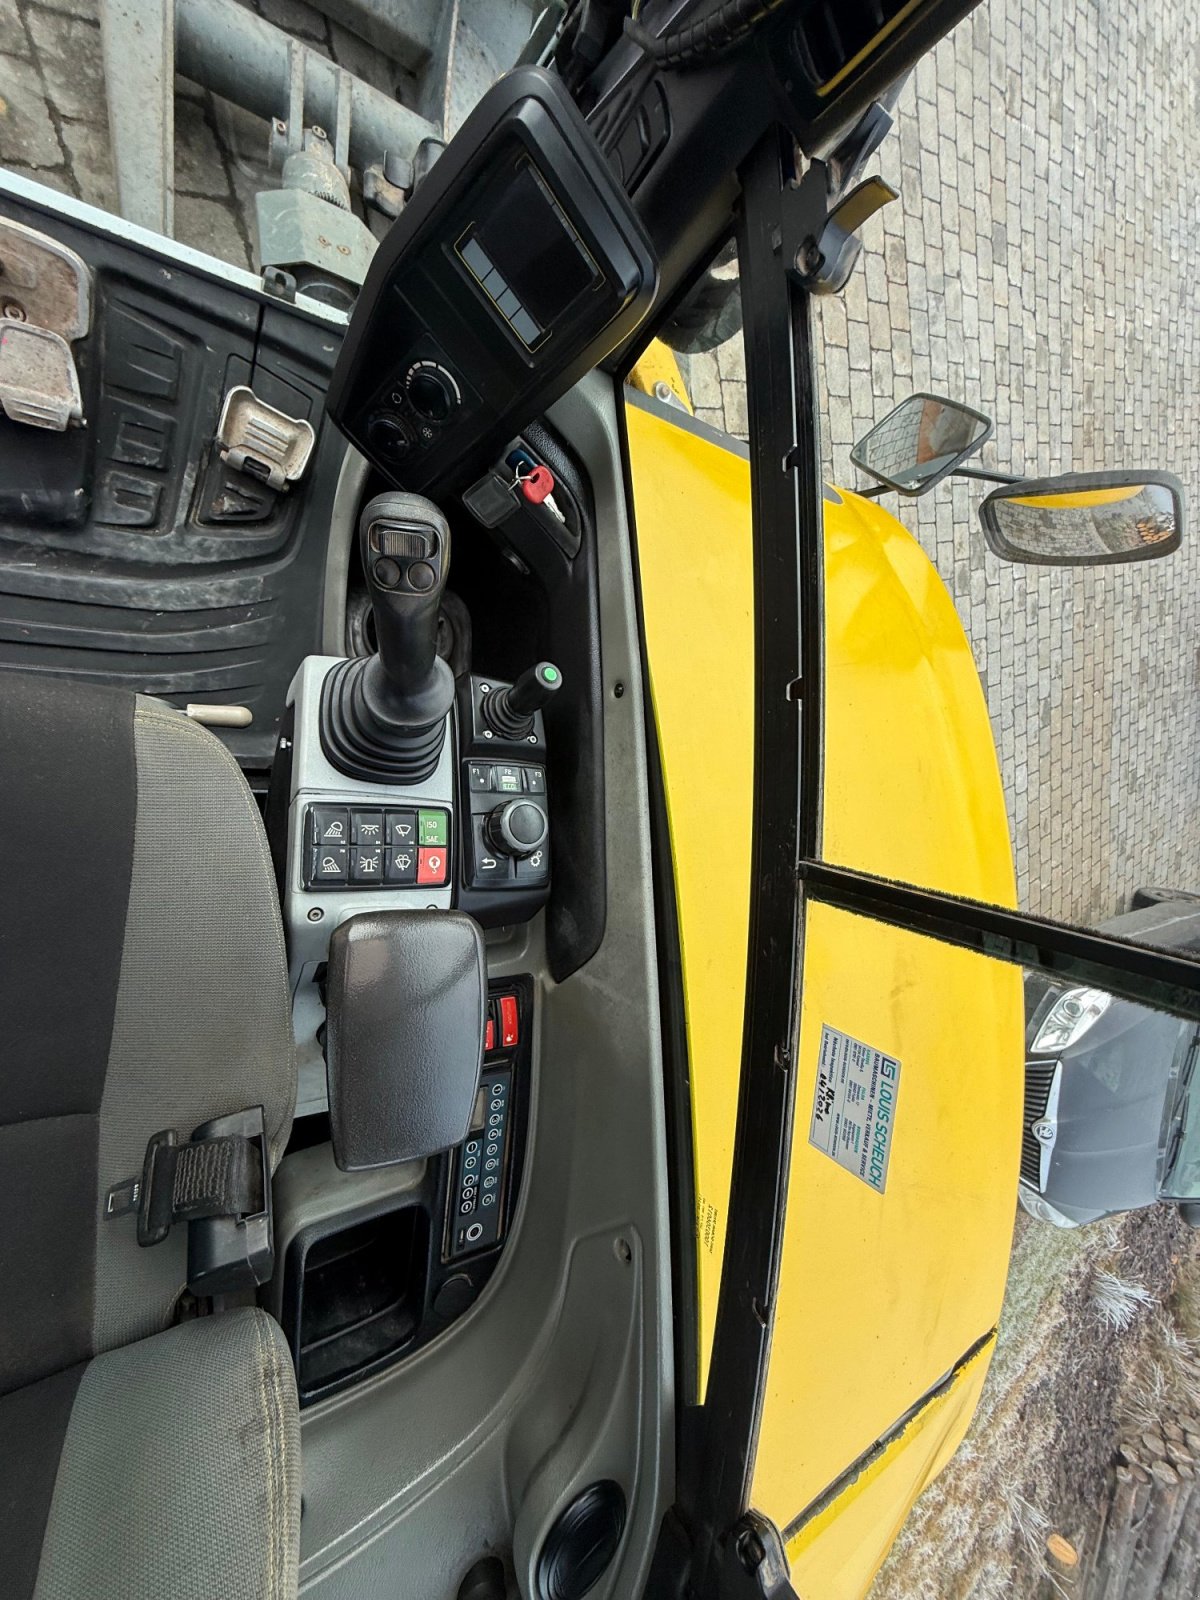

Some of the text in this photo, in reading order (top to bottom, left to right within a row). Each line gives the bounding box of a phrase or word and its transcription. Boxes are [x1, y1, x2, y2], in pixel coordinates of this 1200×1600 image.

[868, 1053, 880, 1098] BAUMASCHINEN
[866, 1104, 874, 1121] MIETE,
[862, 1124, 871, 1148] VERKAUF
[868, 1081, 893, 1188] LOUIS SCHEUCH
